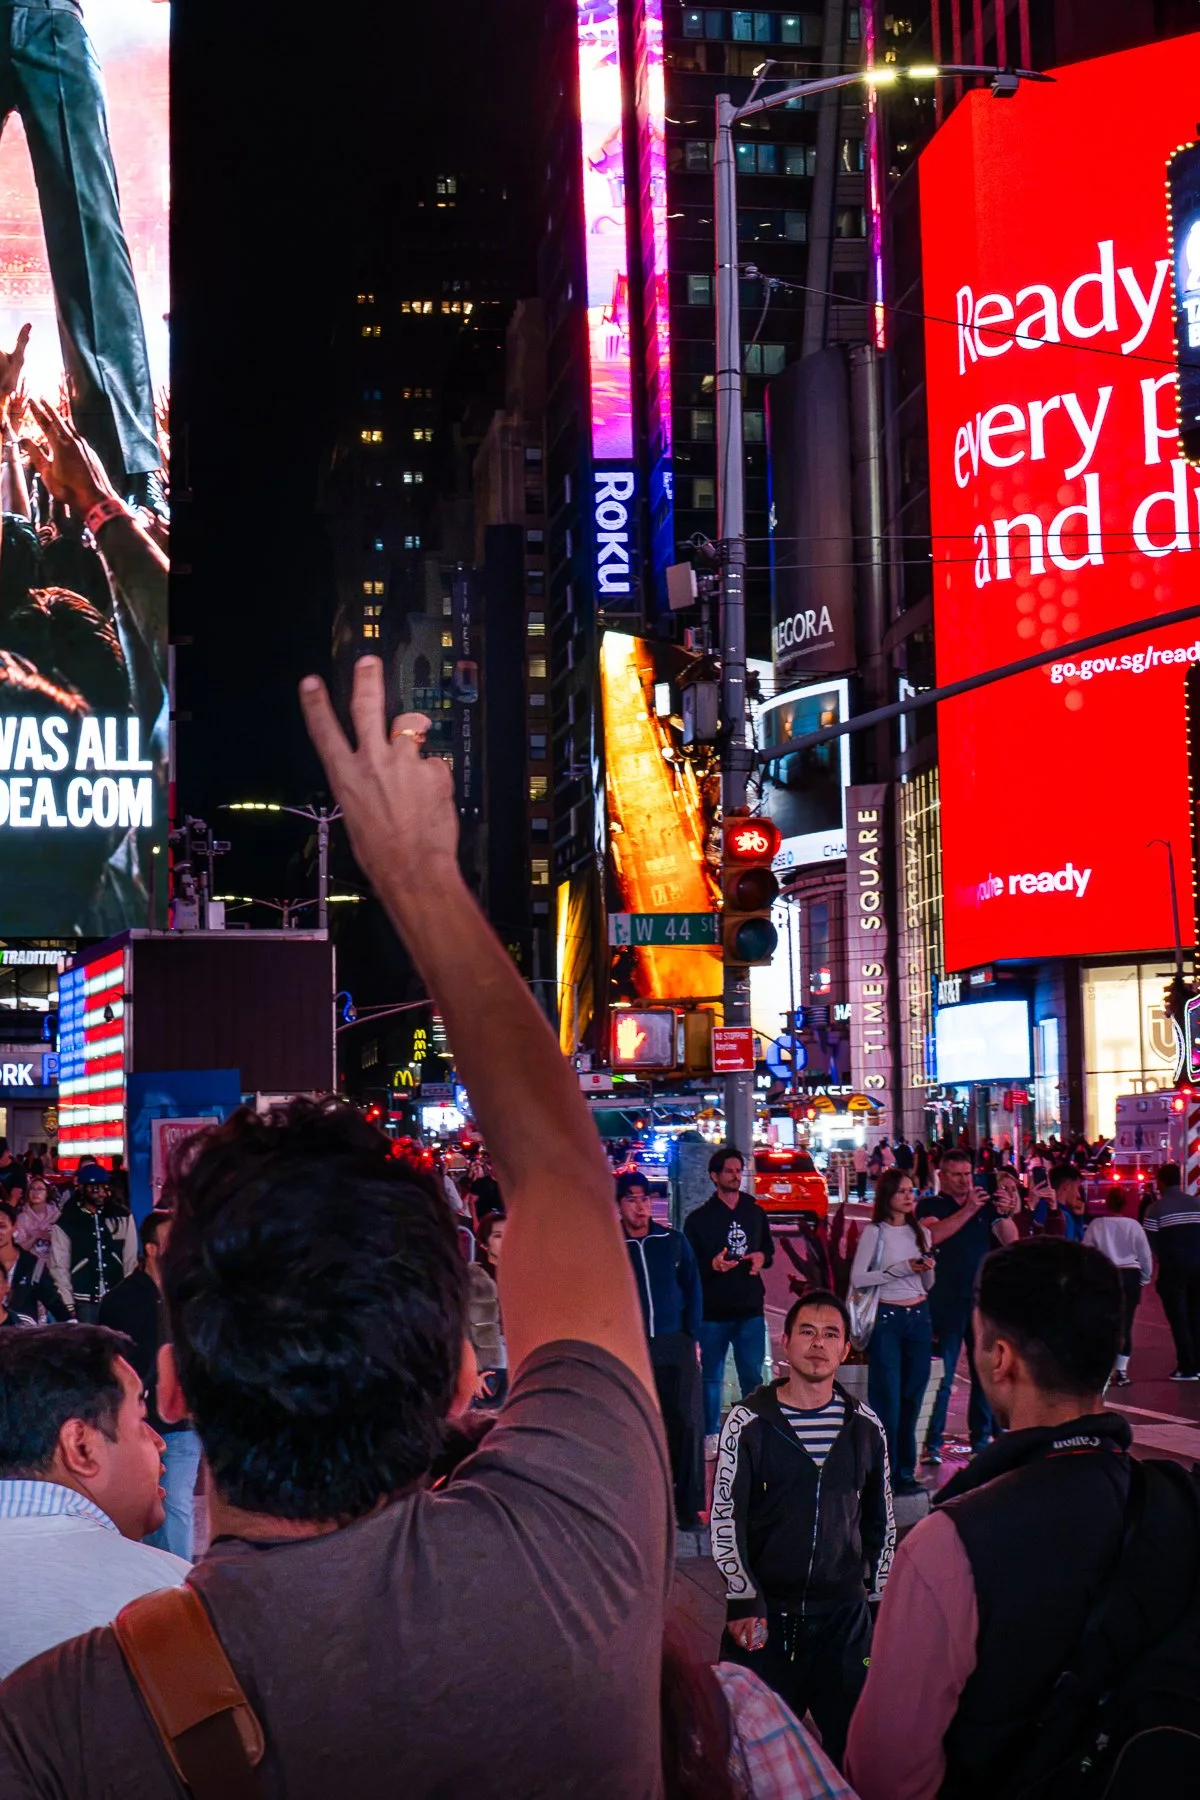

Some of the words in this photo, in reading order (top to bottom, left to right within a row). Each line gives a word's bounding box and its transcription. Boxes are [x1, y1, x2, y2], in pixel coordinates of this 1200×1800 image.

[955, 238, 1172, 376] Ready
[953, 385, 1114, 490] every
[973, 471, 1105, 590] and
[75, 716, 154, 771] ALL
[823, 842, 847, 858] CHA
[857, 808, 882, 931] SQUARE
[1008, 862, 1093, 898] ready
[635, 918, 654, 941] W
[665, 918, 692, 941] 44
[862, 962, 886, 1055] TIMES
[864, 1073, 886, 1090] 3
[1052, 1435, 1102, 1450] Canon
[713, 1468, 736, 1521] Klein
[712, 1525, 748, 1595] Calvin
